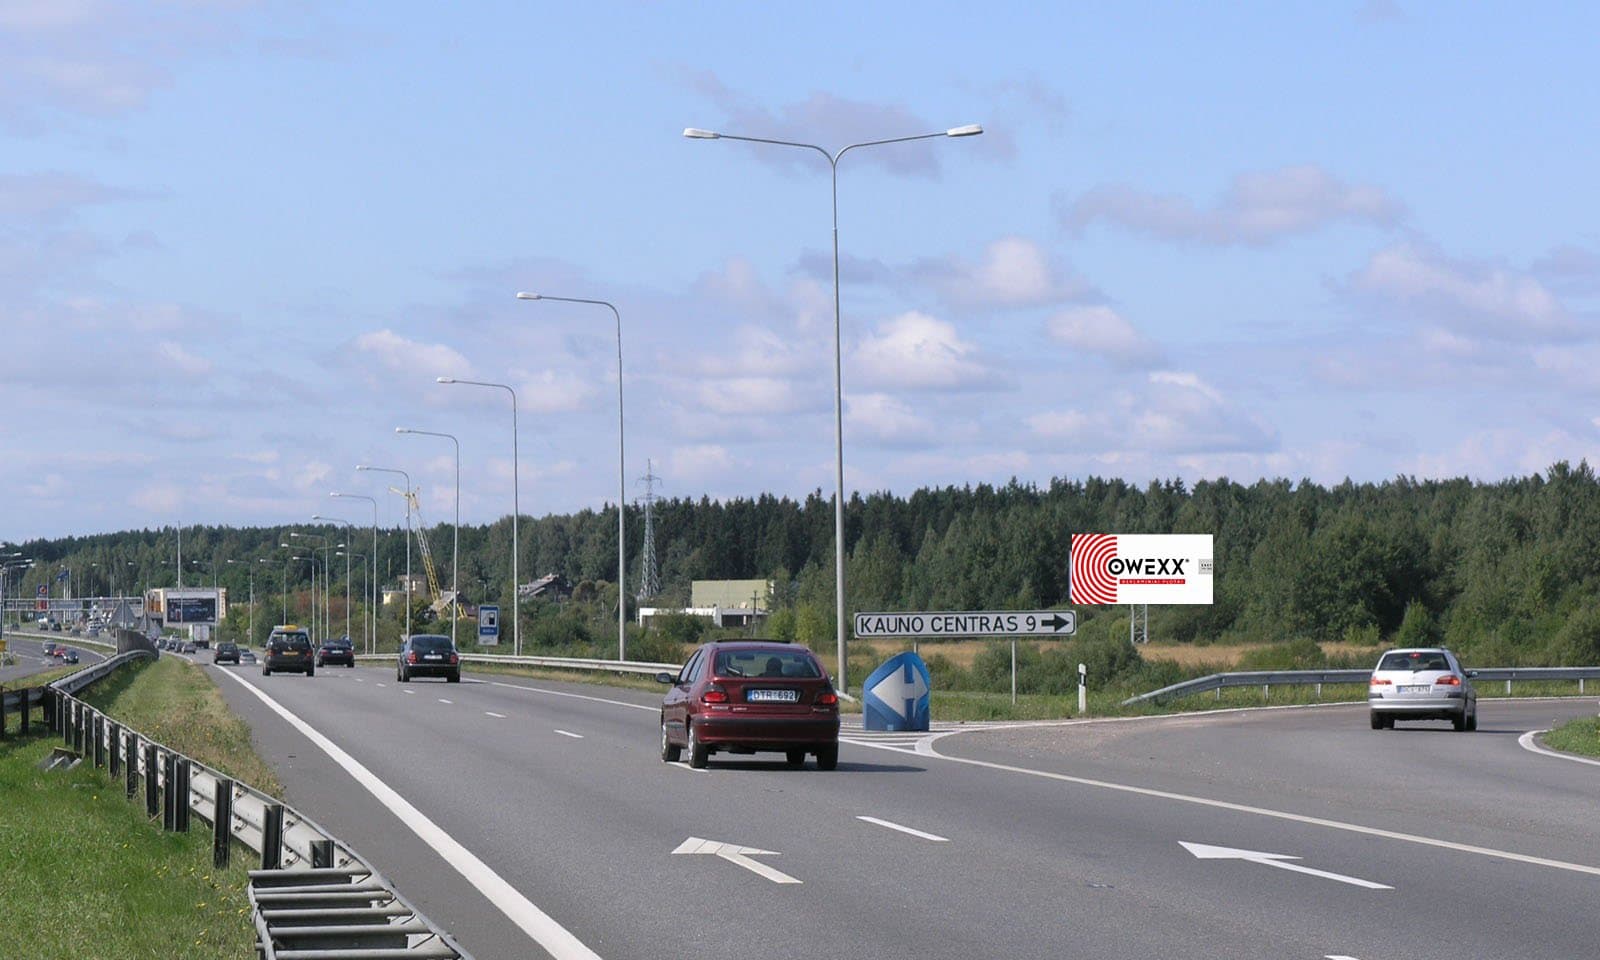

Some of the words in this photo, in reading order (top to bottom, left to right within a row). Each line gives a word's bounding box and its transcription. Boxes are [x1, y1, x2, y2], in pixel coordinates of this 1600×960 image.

[1108, 558, 1185, 575] OWEXX
[860, 616, 924, 633] KAUNO
[931, 615, 1018, 632] CENTRAS
[1025, 615, 1037, 632] 9
[753, 690, 772, 700] DTR
[778, 690, 794, 700] 692
